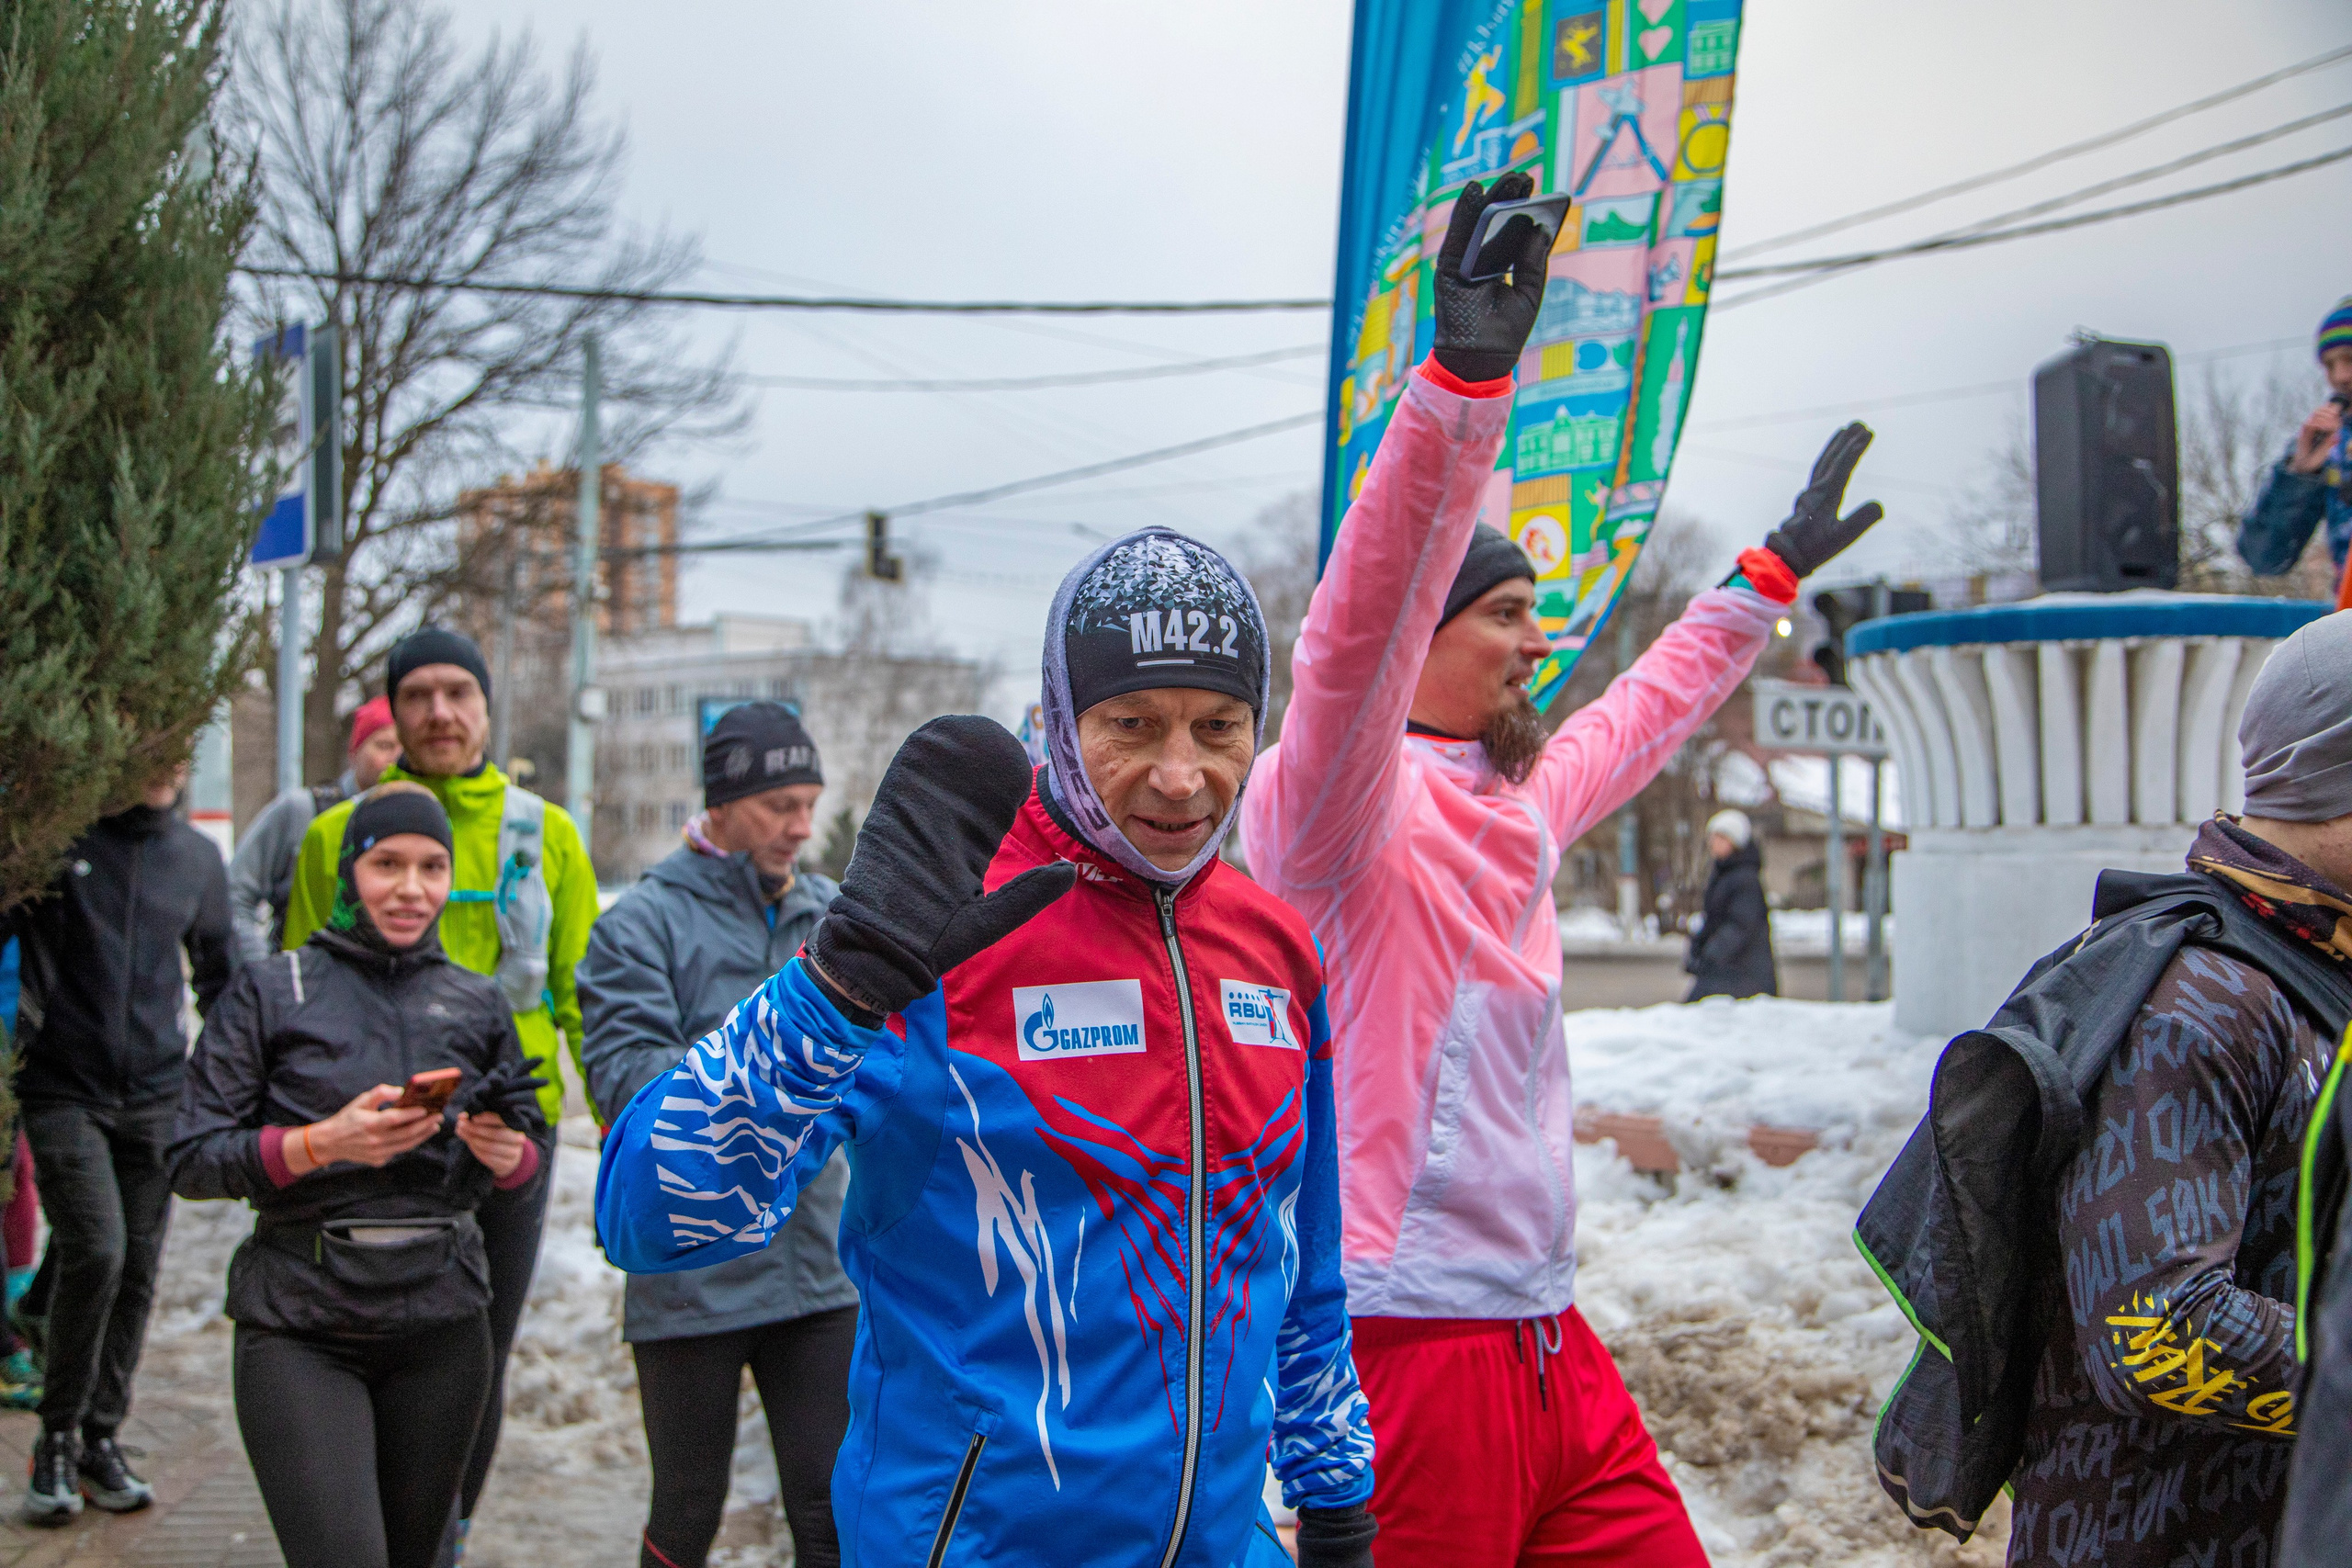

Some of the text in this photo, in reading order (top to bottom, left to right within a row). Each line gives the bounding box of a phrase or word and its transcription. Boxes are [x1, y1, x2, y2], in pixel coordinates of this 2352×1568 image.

[1130, 609, 1239, 659] M42.2
[1228, 1002, 1267, 1020] RBU
[1059, 1023, 1139, 1051] GAZPROM
